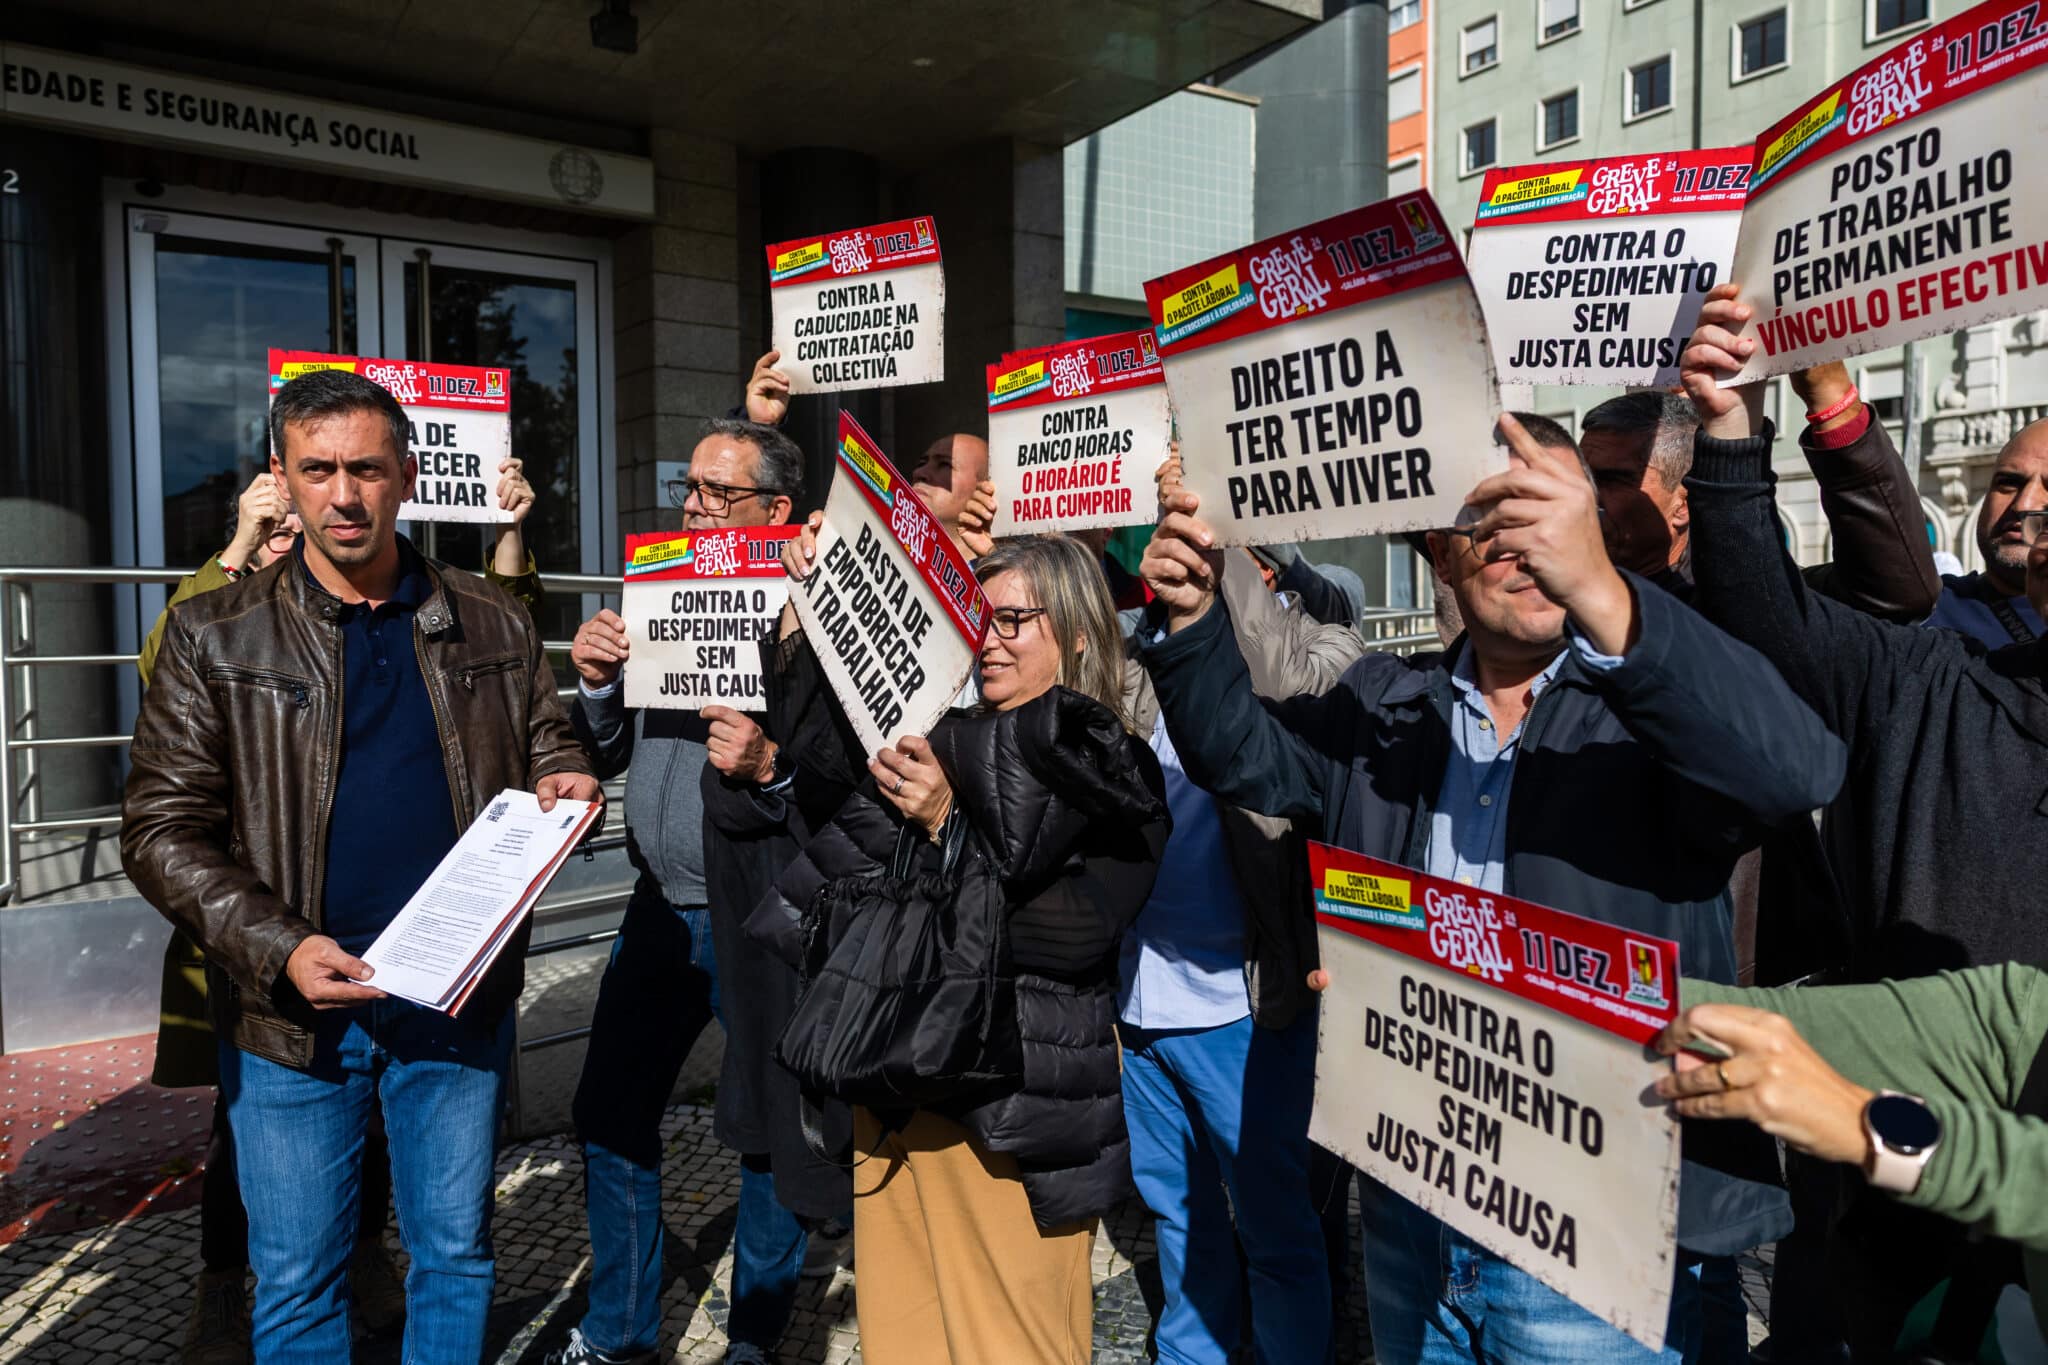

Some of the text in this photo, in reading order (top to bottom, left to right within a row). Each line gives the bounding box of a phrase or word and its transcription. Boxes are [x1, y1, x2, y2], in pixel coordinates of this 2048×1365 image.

[1946, 32, 1972, 75] 11
[1977, 1, 2048, 62] DEZ.
[1851, 40, 1927, 103] GREVE
[4, 64, 419, 160] EDADE E SEGURANÇA SOCIAL
[1847, 68, 1932, 136] GERAL
[1783, 114, 1811, 144] CONTRA
[1796, 110, 1830, 143] LABORAL
[3, 169, 19, 193] 2
[1592, 158, 1661, 189] GREVE
[1674, 167, 1698, 193] 11
[1698, 164, 1752, 192] DEZ
[1830, 127, 1940, 203] POSTO
[1502, 189, 1532, 202] PACOTE
[1533, 182, 1571, 196] LABORAL
[1517, 177, 1550, 190] CONTRA
[1587, 180, 1661, 214] GERAL
[1773, 219, 1811, 265] DE
[1818, 149, 2012, 249] TRABALHO
[829, 231, 865, 253] GREVE
[874, 237, 885, 256] 11
[888, 233, 916, 254] DEZ.
[1327, 240, 1355, 277] 11
[1350, 225, 1411, 271] DEZ.
[1545, 228, 1686, 264] CONTRA O
[1773, 198, 2013, 307] PERMANENTE
[832, 248, 872, 274] GERAL
[1249, 236, 1313, 286] GREVE
[818, 280, 895, 311] CONTRA A
[1182, 280, 1212, 303] CONTRA
[1259, 265, 1331, 319] GERAL
[1506, 261, 1718, 300] DESPEDIMENTO
[794, 303, 919, 337] CADUCIDADE NA
[1167, 283, 1236, 324] O PACOTE LABORAL
[1573, 302, 1630, 333] SEM
[1757, 288, 1890, 357] VÍNCULO
[797, 326, 914, 361] CONTRATAÇÃO
[1510, 338, 1592, 368] JUSTA
[365, 364, 417, 385] GREVE
[812, 357, 897, 384] COLECTIVA
[1008, 369, 1027, 381] CONTRA
[1020, 371, 1041, 385] LABORAL
[1051, 348, 1089, 377] GREVE
[1096, 355, 1109, 376] 11
[1110, 348, 1141, 374] DEZ.
[1231, 329, 1403, 412] DIREITO A
[428, 376, 442, 393] 11
[446, 376, 482, 396] DEZ.
[1052, 367, 1094, 397] GERAL
[426, 421, 457, 448] DE
[1042, 405, 1108, 437] CONTRA
[1226, 386, 1422, 466] TER TEMPO
[1017, 429, 1133, 467] BANCO HORAS
[1022, 455, 1122, 494] O HORÁRIO É
[1227, 447, 1435, 520] PARA VIVER
[896, 488, 929, 538] GREVE
[1013, 487, 1132, 522] PARA CUMPRIR
[649, 544, 670, 553] CONTRA
[696, 531, 737, 555] GREVE
[748, 540, 762, 561] 11
[892, 508, 927, 564] GERAL
[640, 553, 659, 562] PACOTE
[660, 548, 684, 559] LABORAL
[694, 548, 741, 576] GERAL
[855, 522, 908, 616] BASTA
[902, 598, 933, 649] DE
[931, 544, 967, 611] 11 DEZ.
[671, 589, 766, 614] CONTRA O
[823, 536, 926, 703] EMPOBRECER
[696, 646, 736, 669] SEM
[802, 565, 903, 740] A TRABALHAR
[660, 672, 712, 697] JUSTA
[1328, 884, 1406, 910] O PACOTE LABORAL
[1347, 874, 1380, 890] CONTRA
[1425, 888, 1502, 940] GREVE
[1429, 922, 1513, 983] GERAL
[1520, 928, 1547, 972] 11
[1550, 936, 1621, 998] DEZ.
[1400, 975, 1524, 1066] CONTRA
[1533, 1029, 1555, 1077] O
[1365, 1007, 1603, 1157] DESPEDIMENTO
[1437, 1094, 1502, 1165] SEM
[1367, 1112, 1577, 1268] JUSTA CAUSA
